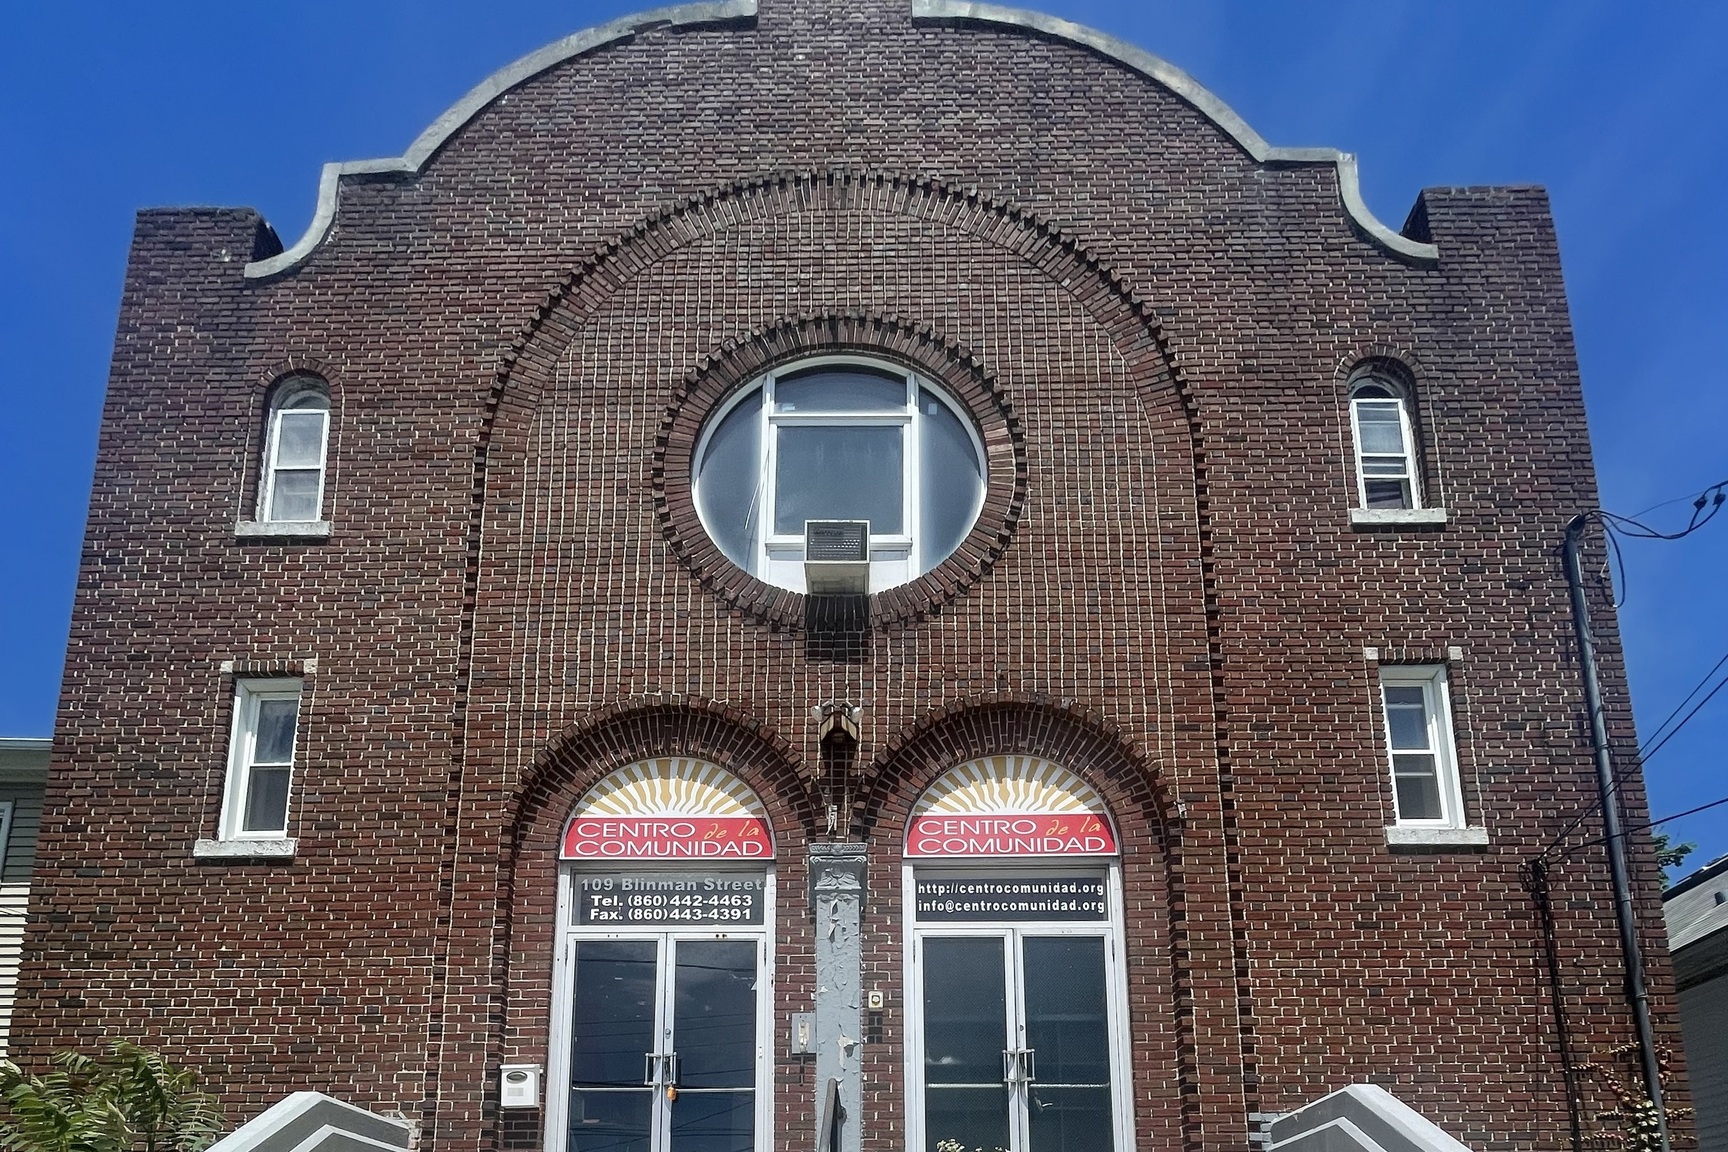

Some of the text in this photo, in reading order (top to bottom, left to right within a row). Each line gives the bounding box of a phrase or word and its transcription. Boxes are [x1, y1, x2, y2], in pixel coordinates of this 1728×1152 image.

[577, 819, 760, 840] CENTRO de la
[918, 816, 1101, 836] CENTRO de la
[575, 840, 763, 856] COMUNIDAD
[917, 837, 1106, 853] COMUNIDAD
[581, 877, 763, 891] 109 Blinman Street
[918, 882, 1104, 897] http://centrocomunidad.org
[590, 895, 623, 907] Tel.
[918, 899, 1105, 914] info@centrocomunidad.org
[590, 908, 624, 921] Fax.
